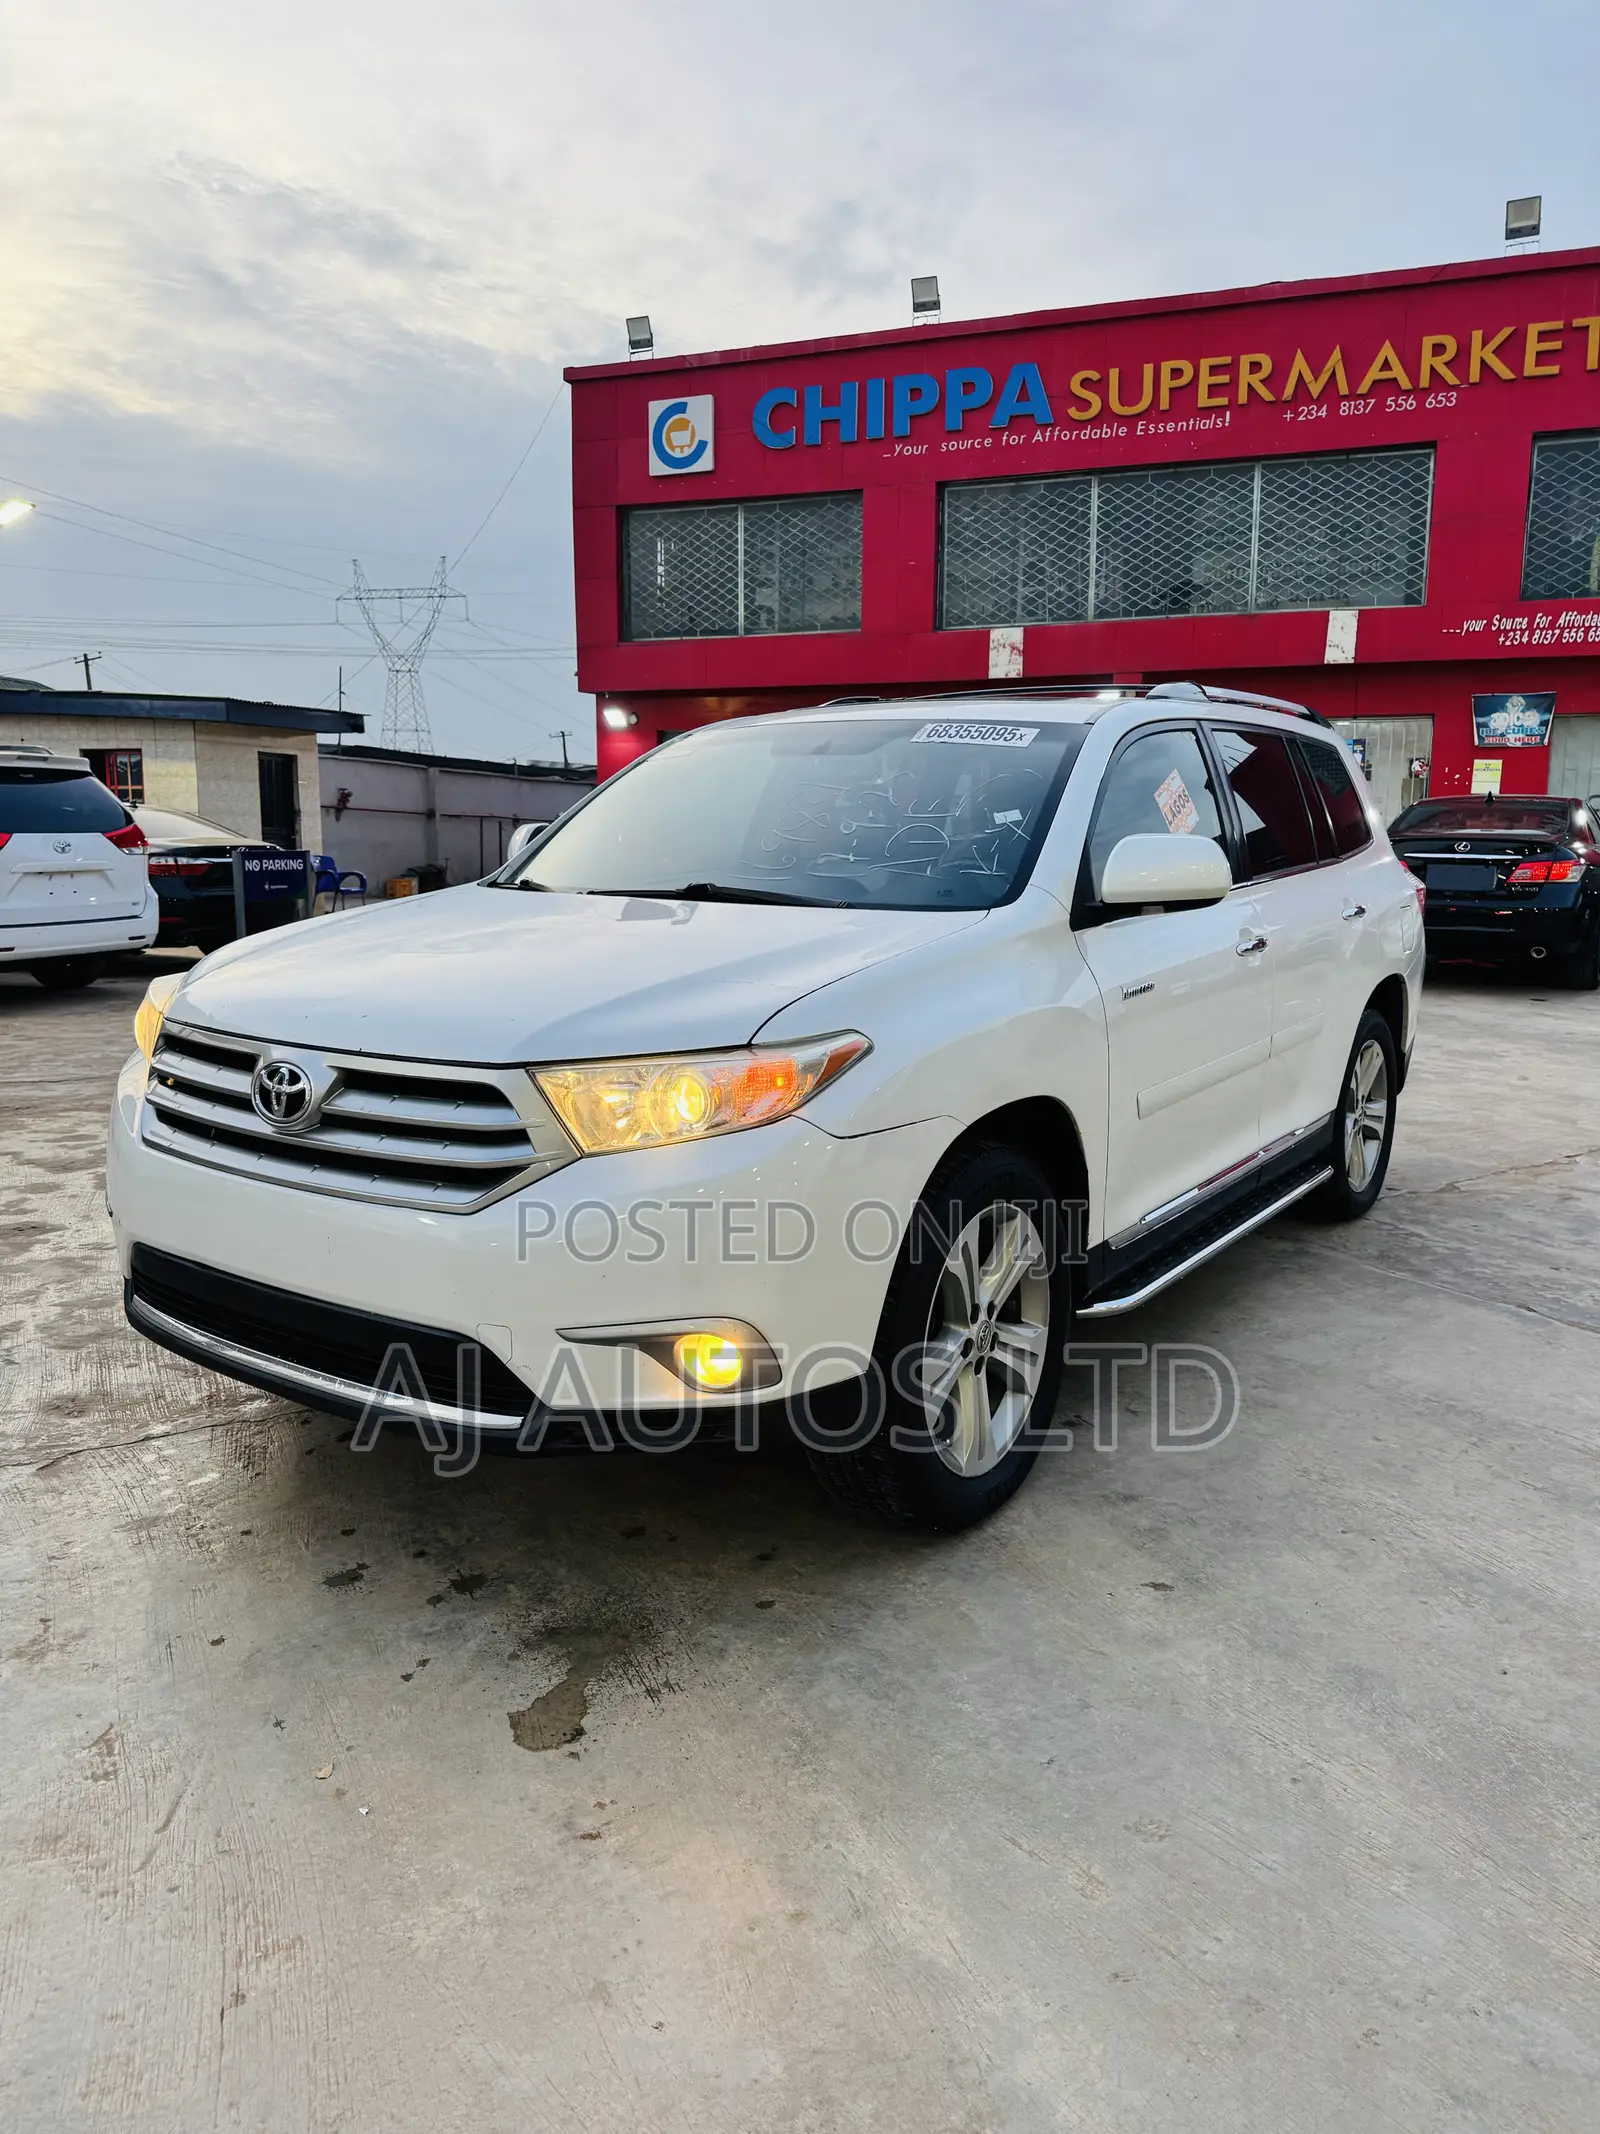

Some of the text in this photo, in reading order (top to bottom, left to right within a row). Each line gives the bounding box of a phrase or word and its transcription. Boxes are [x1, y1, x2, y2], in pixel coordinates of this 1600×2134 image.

[753, 316, 1600, 449] CHIPPA SUPERMARKET
[1283, 391, 1457, 421] +234 8137 556 653
[940, 437, 993, 452] source
[1002, 431, 1026, 446] for
[1032, 422, 1128, 443] Affordable
[1136, 410, 1231, 435] Essentials!
[1491, 614, 1529, 632] Source
[1533, 613, 1552, 629] For
[1498, 630, 1529, 646] +234
[1532, 629, 1560, 644] 8137
[1562, 627, 1585, 643] 556
[1504, 726, 1546, 735] CUBES
[1164, 788, 1190, 826] LAGOS
[245, 859, 304, 871] NO PARKING
